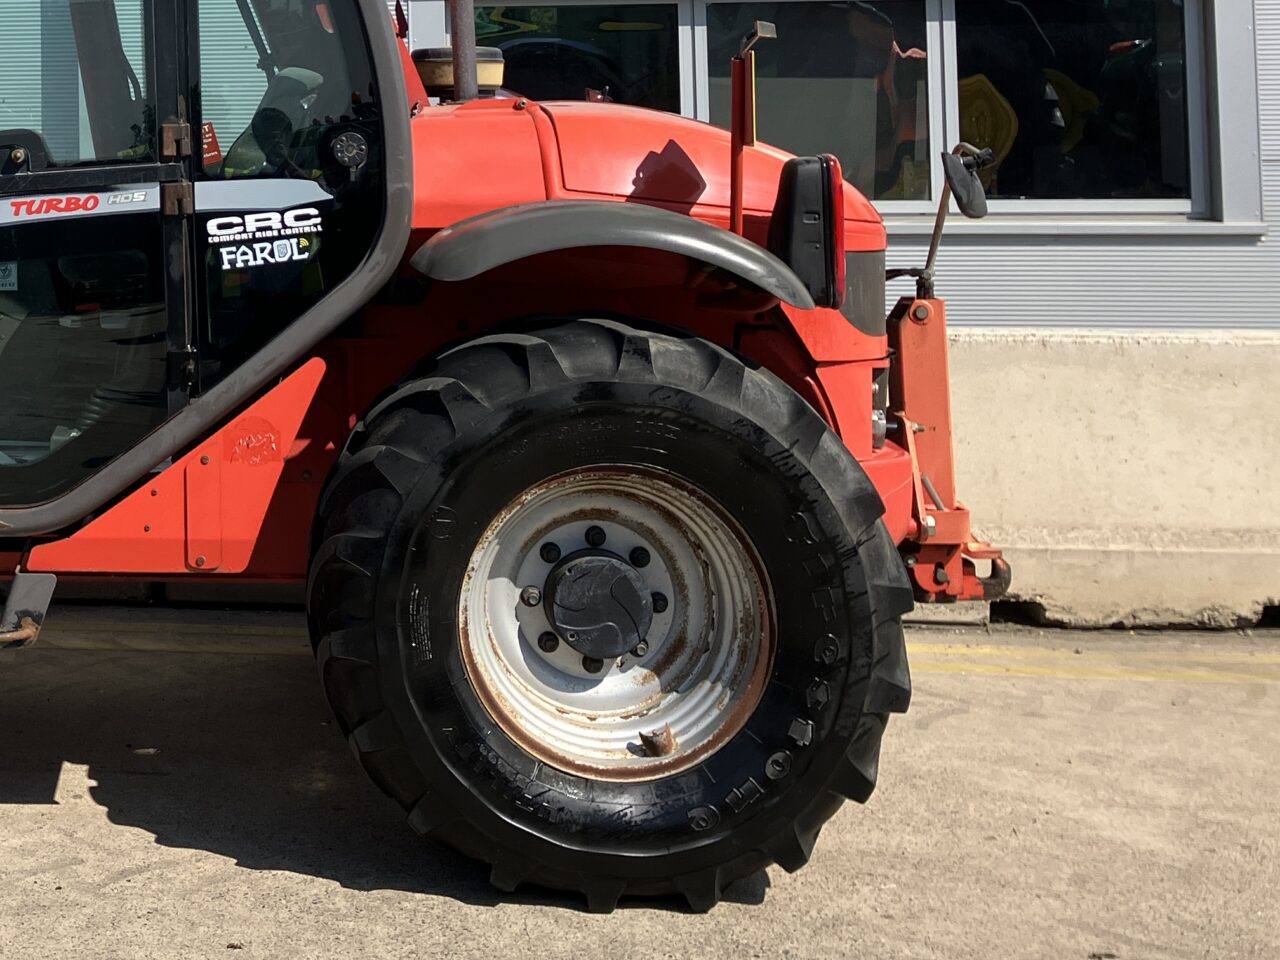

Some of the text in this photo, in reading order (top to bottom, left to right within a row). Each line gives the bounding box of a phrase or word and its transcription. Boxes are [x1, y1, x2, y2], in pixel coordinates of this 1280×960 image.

[10, 194, 100, 217] TURBO
[206, 208, 322, 236] CRC
[207, 232, 254, 243] COMFORT
[255, 229, 279, 239] RIDE
[220, 237, 310, 270] FAROL
